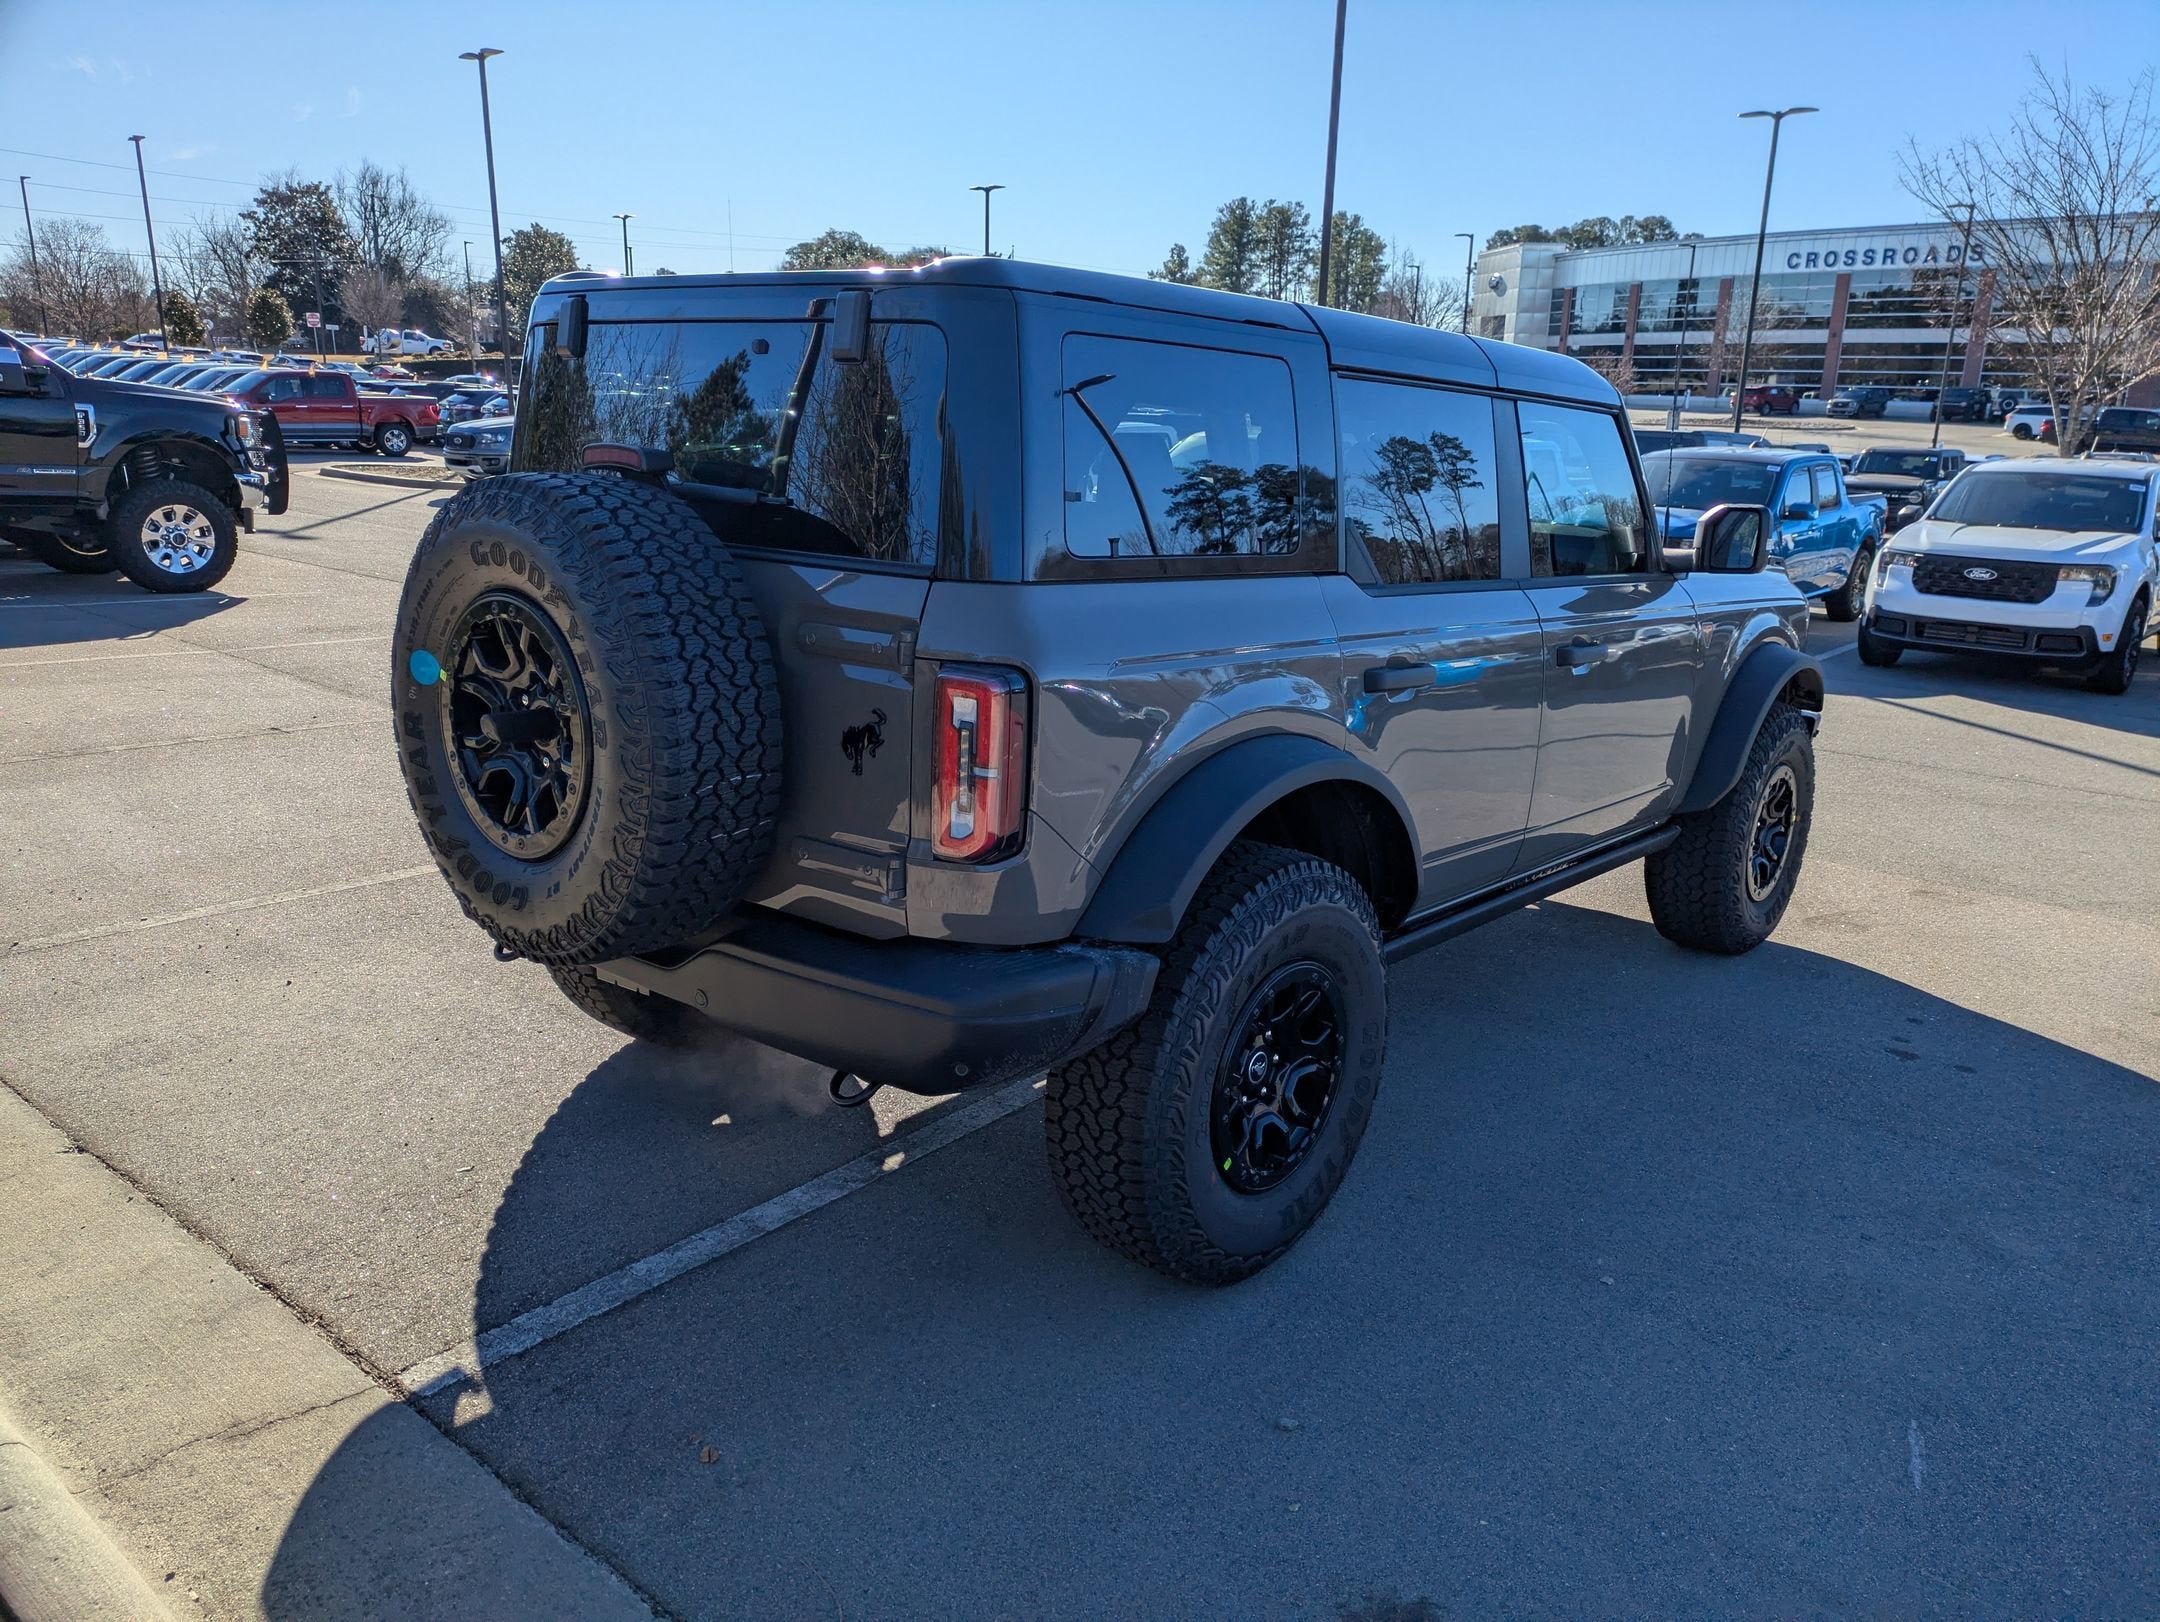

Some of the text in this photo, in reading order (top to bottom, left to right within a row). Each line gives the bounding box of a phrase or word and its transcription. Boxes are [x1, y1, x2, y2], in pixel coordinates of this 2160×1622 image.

[1787, 243, 1984, 269] CROSSROADS
[1967, 568, 1995, 581] Ford
[469, 540, 608, 750] GOODYEAR
[403, 711, 529, 912] GOODYEAR
